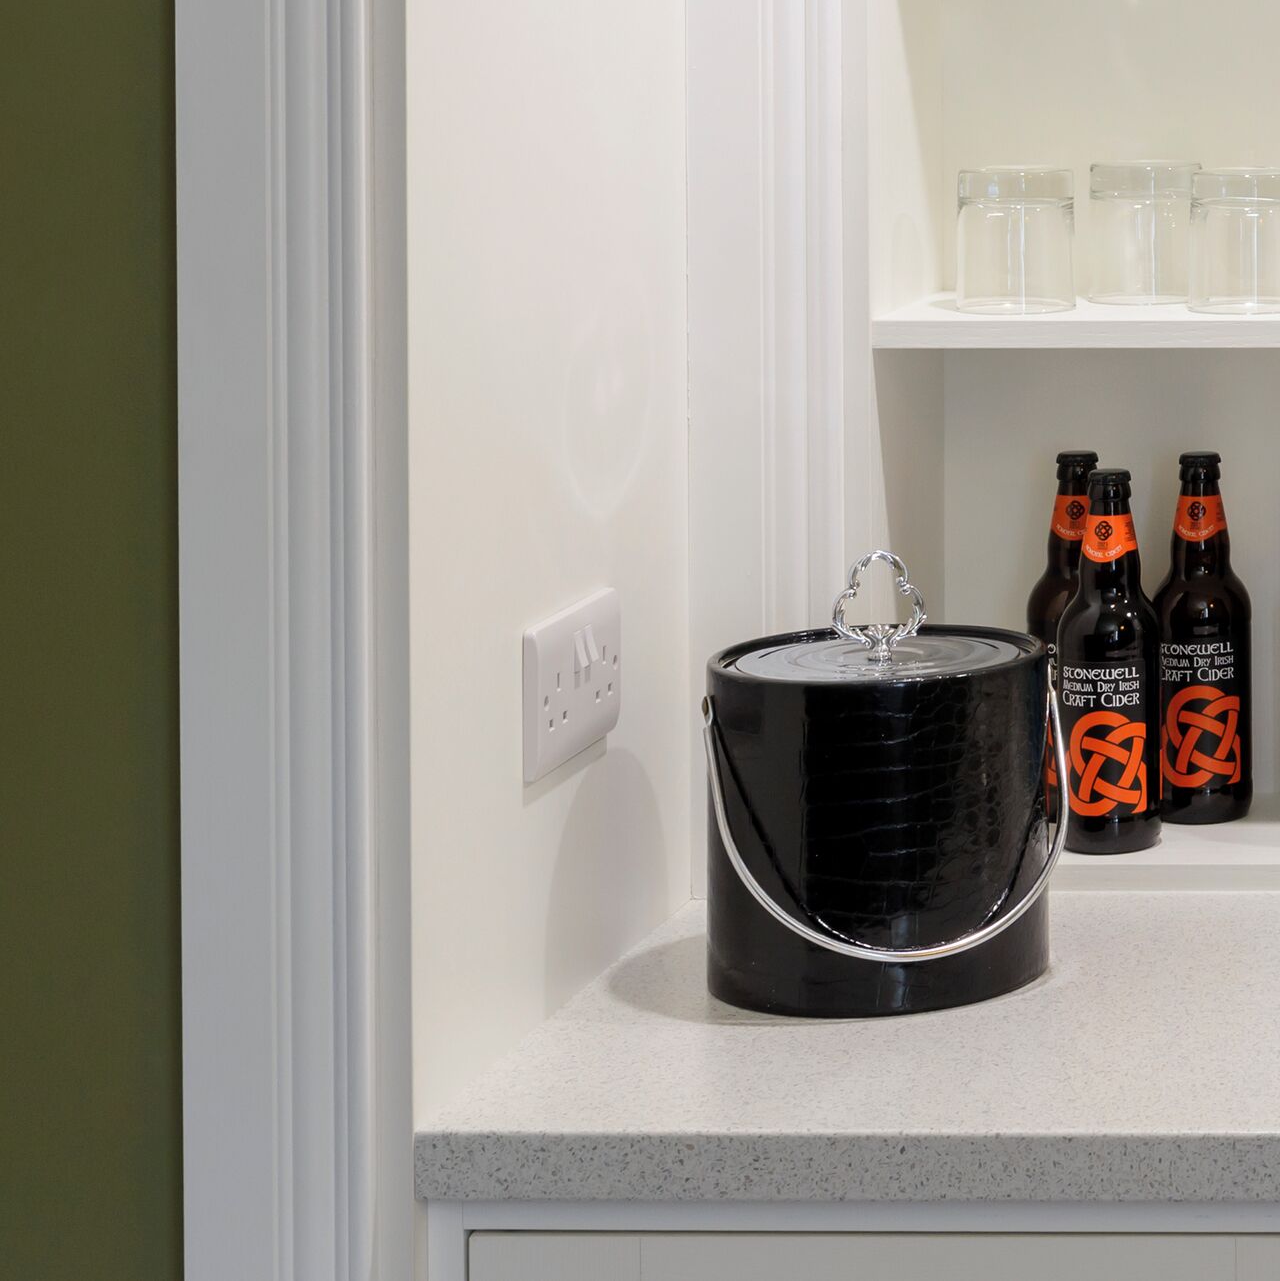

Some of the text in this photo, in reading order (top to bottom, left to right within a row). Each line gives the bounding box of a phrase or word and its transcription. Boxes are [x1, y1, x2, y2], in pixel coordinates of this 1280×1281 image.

[1194, 656, 1212, 668] DRY
[1215, 655, 1234, 666] IRISH
[1063, 666, 1140, 681] STONEWELL
[1197, 667, 1235, 682] CIDER
[1063, 681, 1140, 693] MEDIUM DRY IRISH
[1063, 691, 1140, 708] CRAFT CIDER
